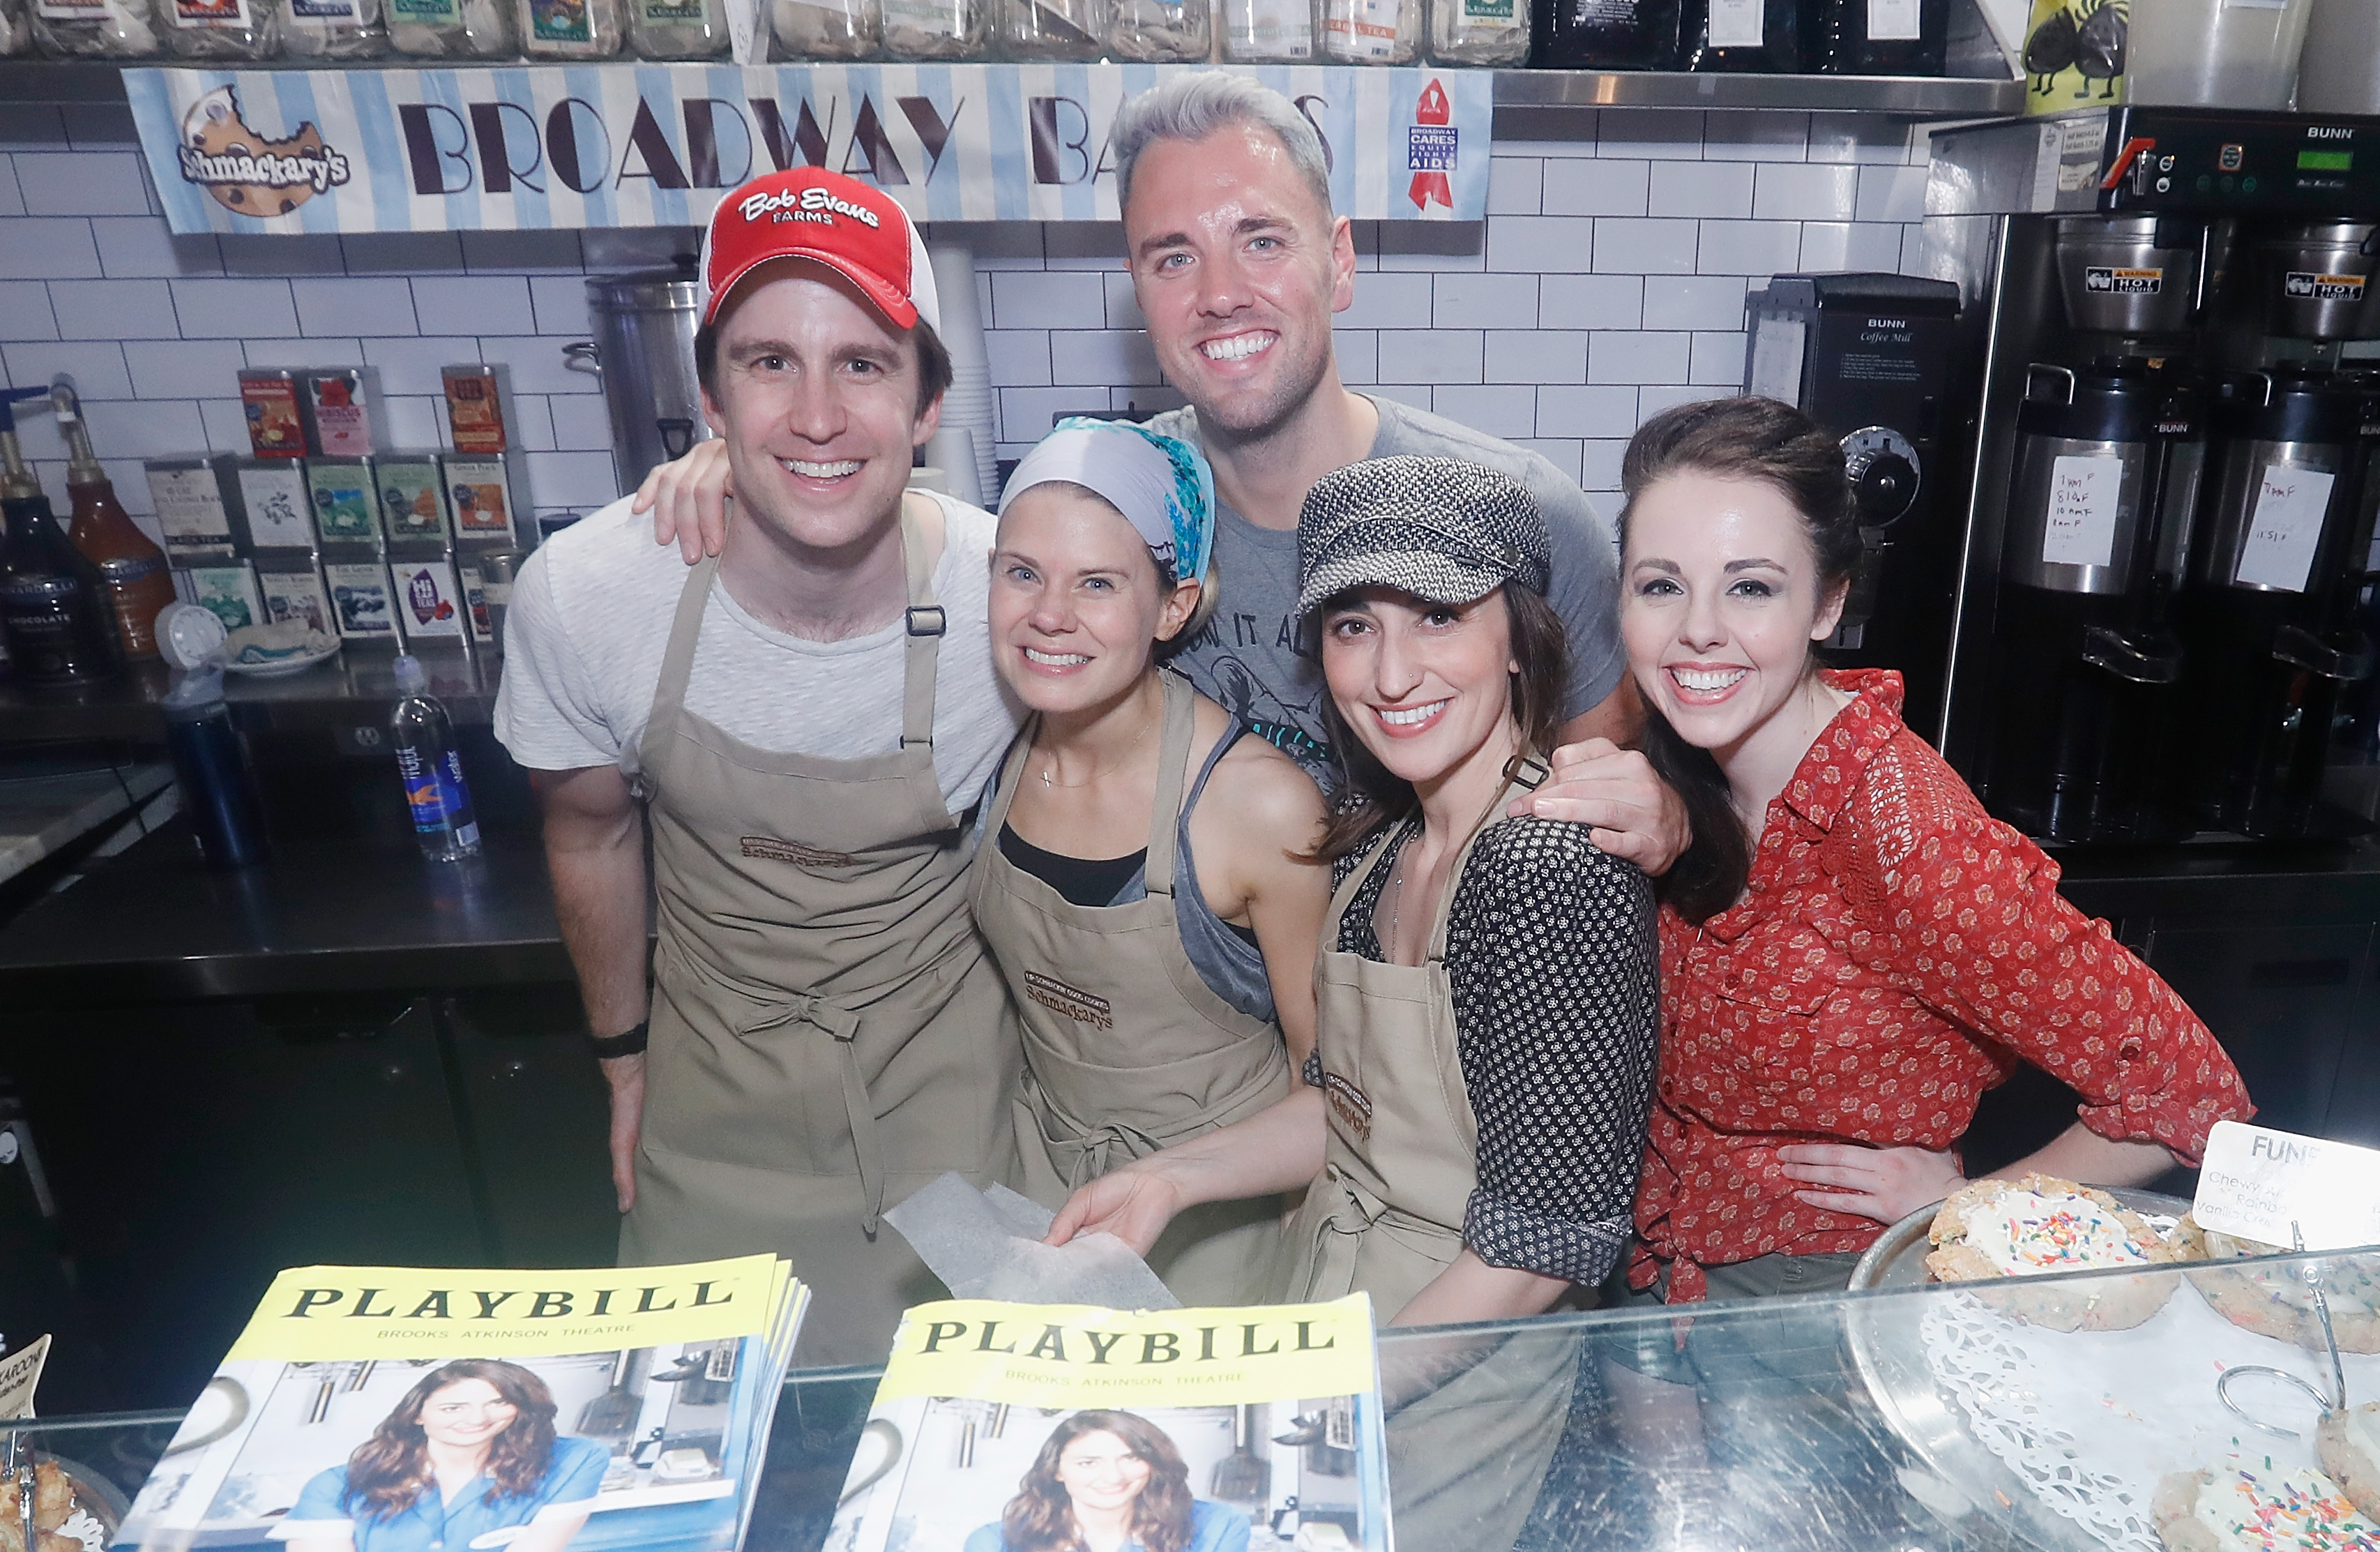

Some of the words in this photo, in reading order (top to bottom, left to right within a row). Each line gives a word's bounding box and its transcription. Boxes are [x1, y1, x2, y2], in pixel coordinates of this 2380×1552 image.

[1368, 27, 1387, 38] TEA
[1411, 135, 1456, 144] CARES
[2307, 126, 2353, 139] BUNN
[398, 95, 965, 195] BROADWAY
[179, 144, 349, 195] Schmackary's
[1410, 158, 1456, 168] AIDS
[738, 188, 796, 221] Bob
[801, 187, 879, 228] Evans
[773, 210, 833, 225] FARMS
[2322, 285, 2356, 293] HOT
[1868, 319, 1906, 328] BUNN
[1860, 332, 1889, 344] Coffee
[1891, 332, 1913, 342] Mill
[2159, 424, 2188, 432] BUNN
[1233, 611, 1257, 648] IT
[2208, 1170, 2260, 1193] Chewy
[2236, 1193, 2287, 1215] Rainbo
[280, 1279, 734, 1320] PLAYBILL
[377, 1329, 449, 1340] BROOKS
[461, 1329, 548, 1339] ATKINSON
[561, 1324, 637, 1337] THEATRE
[916, 1319, 1337, 1366] PLAYBILL
[1005, 1369, 1071, 1387] BROOKS
[1081, 1376, 1163, 1387] ATKINSON
[1176, 1371, 1247, 1385] THEATRE
